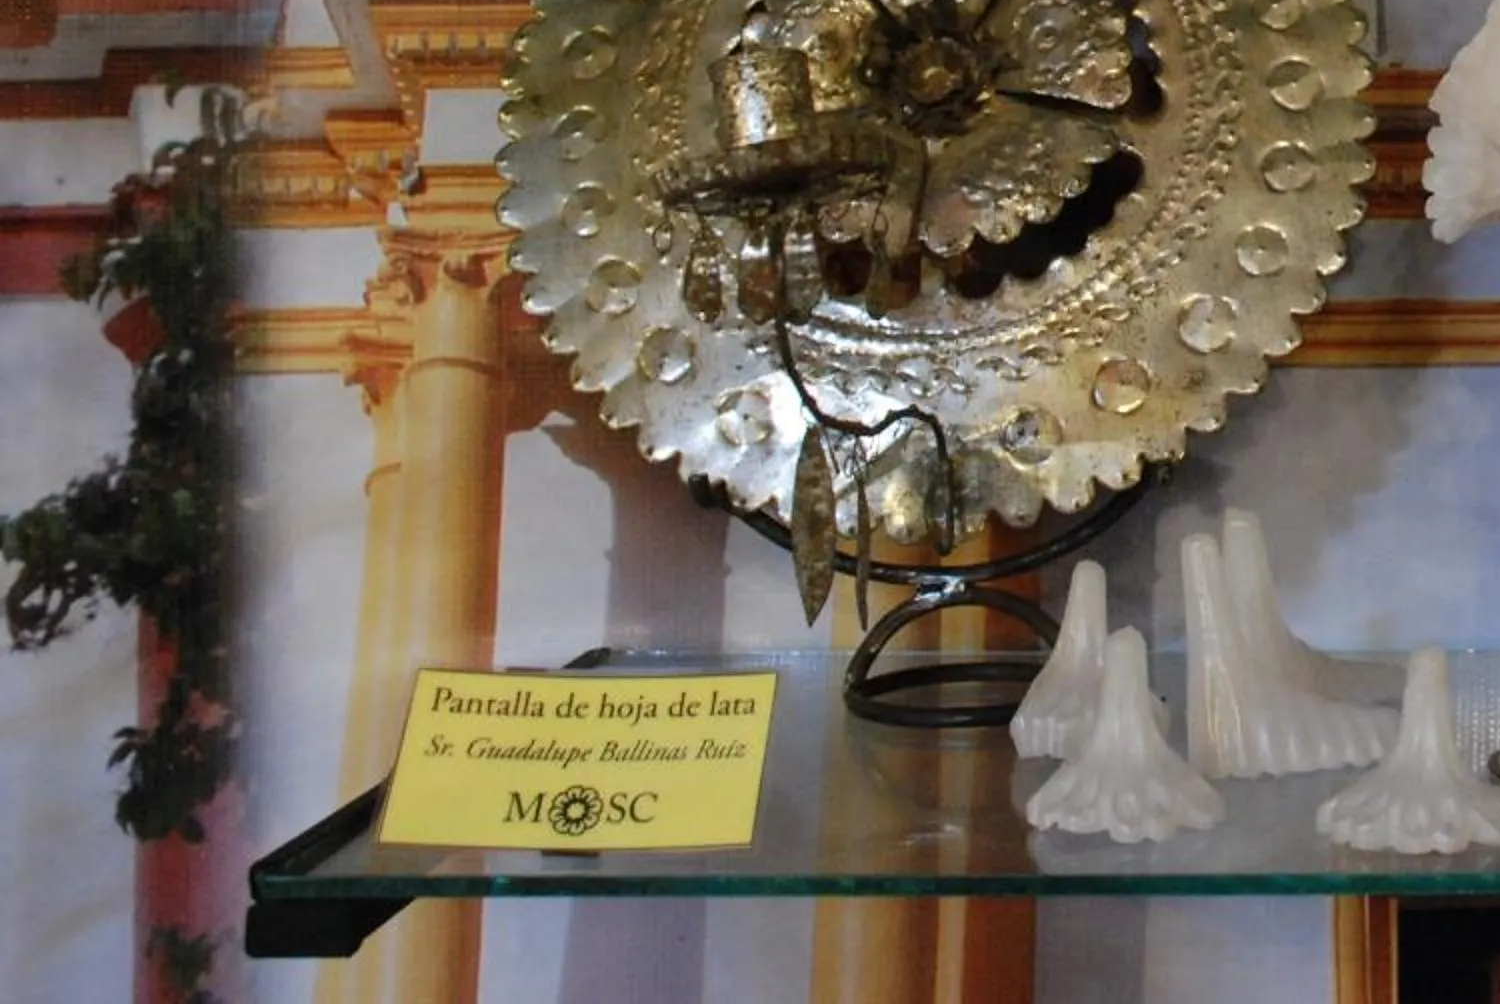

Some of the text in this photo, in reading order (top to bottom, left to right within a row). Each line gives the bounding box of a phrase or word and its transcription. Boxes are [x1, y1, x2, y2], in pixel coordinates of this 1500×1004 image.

[431, 686, 756, 726] Pantalla de hoja de lata
[424, 735, 453, 757] Sr.
[466, 737, 593, 768] Guadalupe
[600, 740, 688, 762] Ballinas
